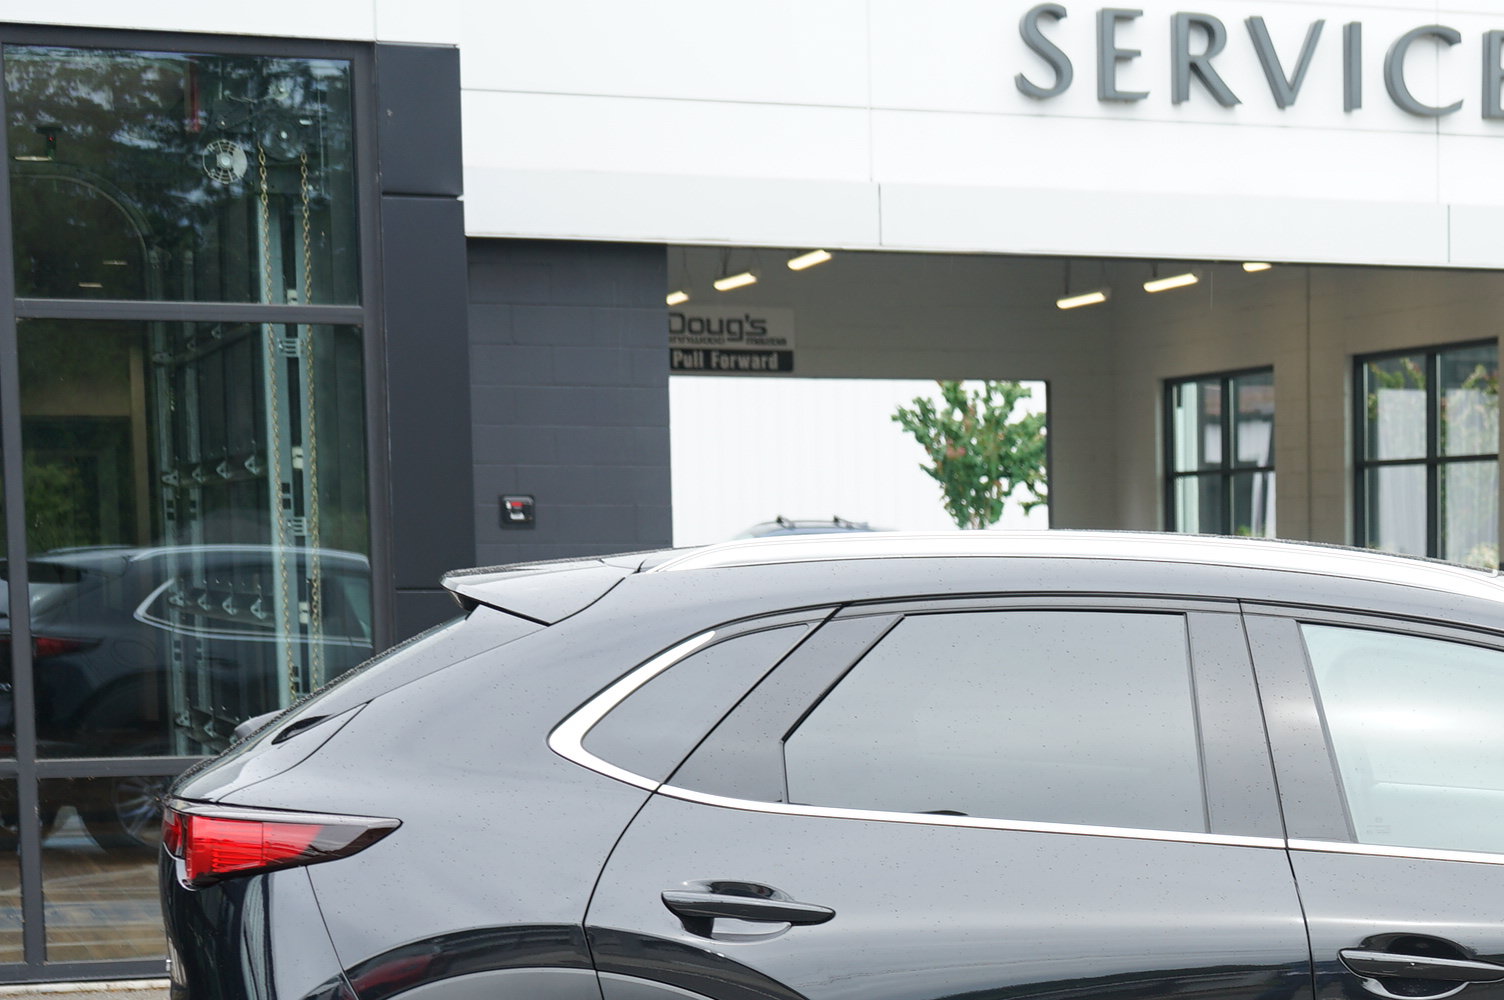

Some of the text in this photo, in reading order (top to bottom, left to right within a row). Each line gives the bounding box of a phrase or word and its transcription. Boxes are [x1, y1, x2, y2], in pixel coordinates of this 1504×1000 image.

[669, 312, 768, 342] Doug's
[672, 350, 779, 370] Pull Forward
